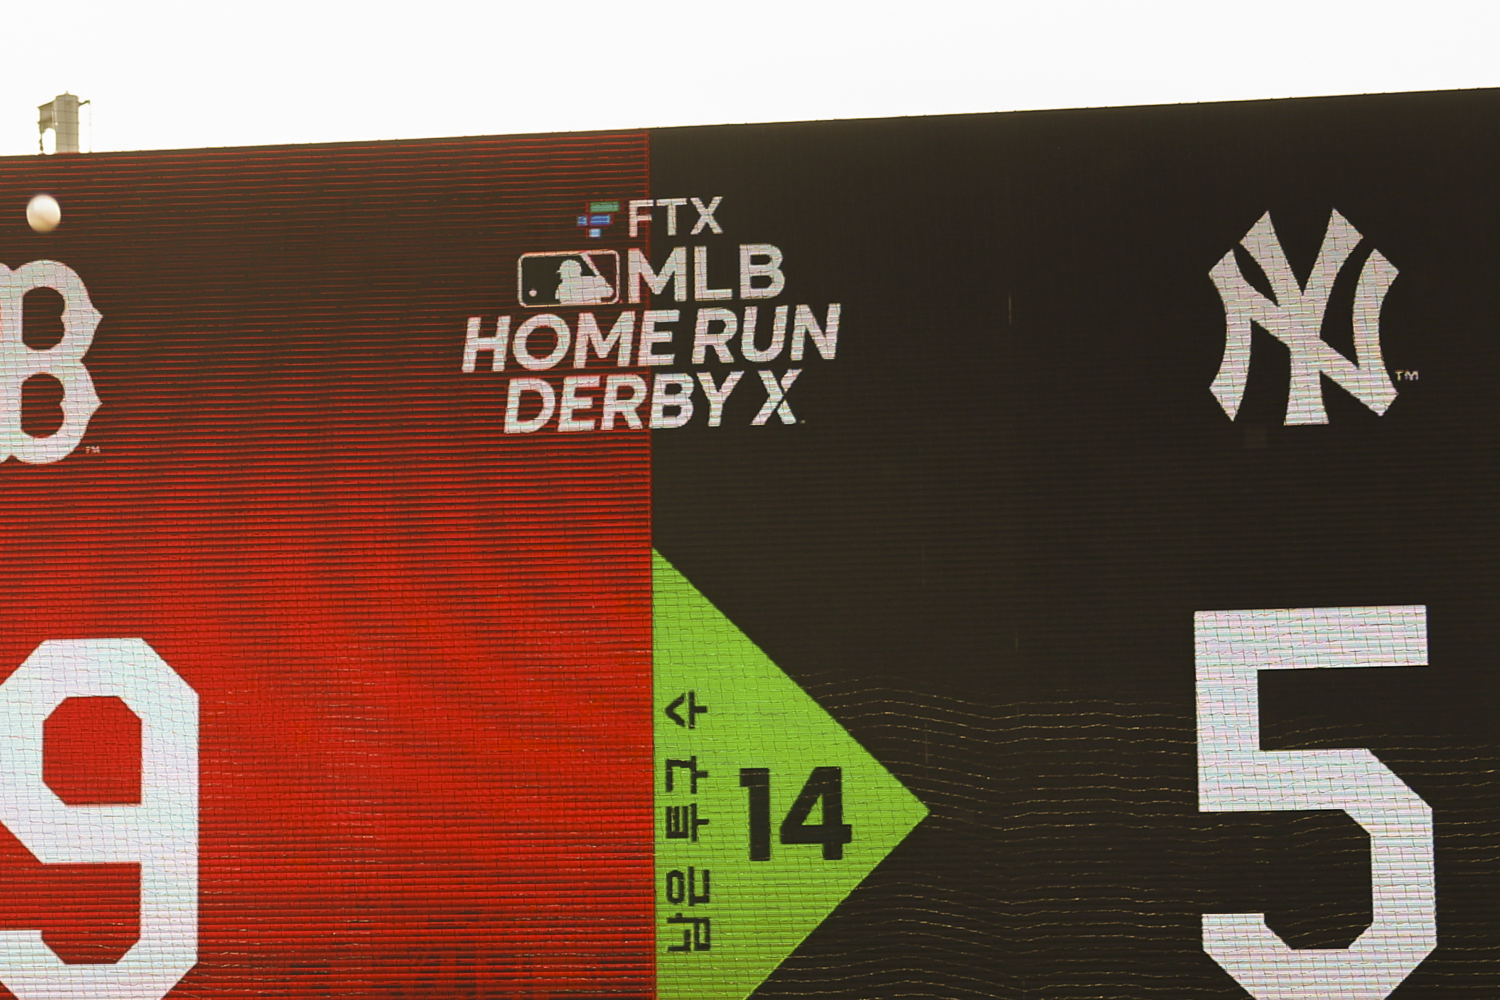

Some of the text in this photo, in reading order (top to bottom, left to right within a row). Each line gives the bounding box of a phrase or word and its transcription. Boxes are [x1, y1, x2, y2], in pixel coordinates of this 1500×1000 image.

[628, 196, 724, 238] FTX
[627, 243, 786, 304] MLB
[461, 303, 842, 373] HOME RUN
[1208, 207, 1400, 426] NY
[503, 369, 802, 434] DERBY X
[664, 689, 712, 953] 남은 투구 수
[738, 766, 853, 862] 14
